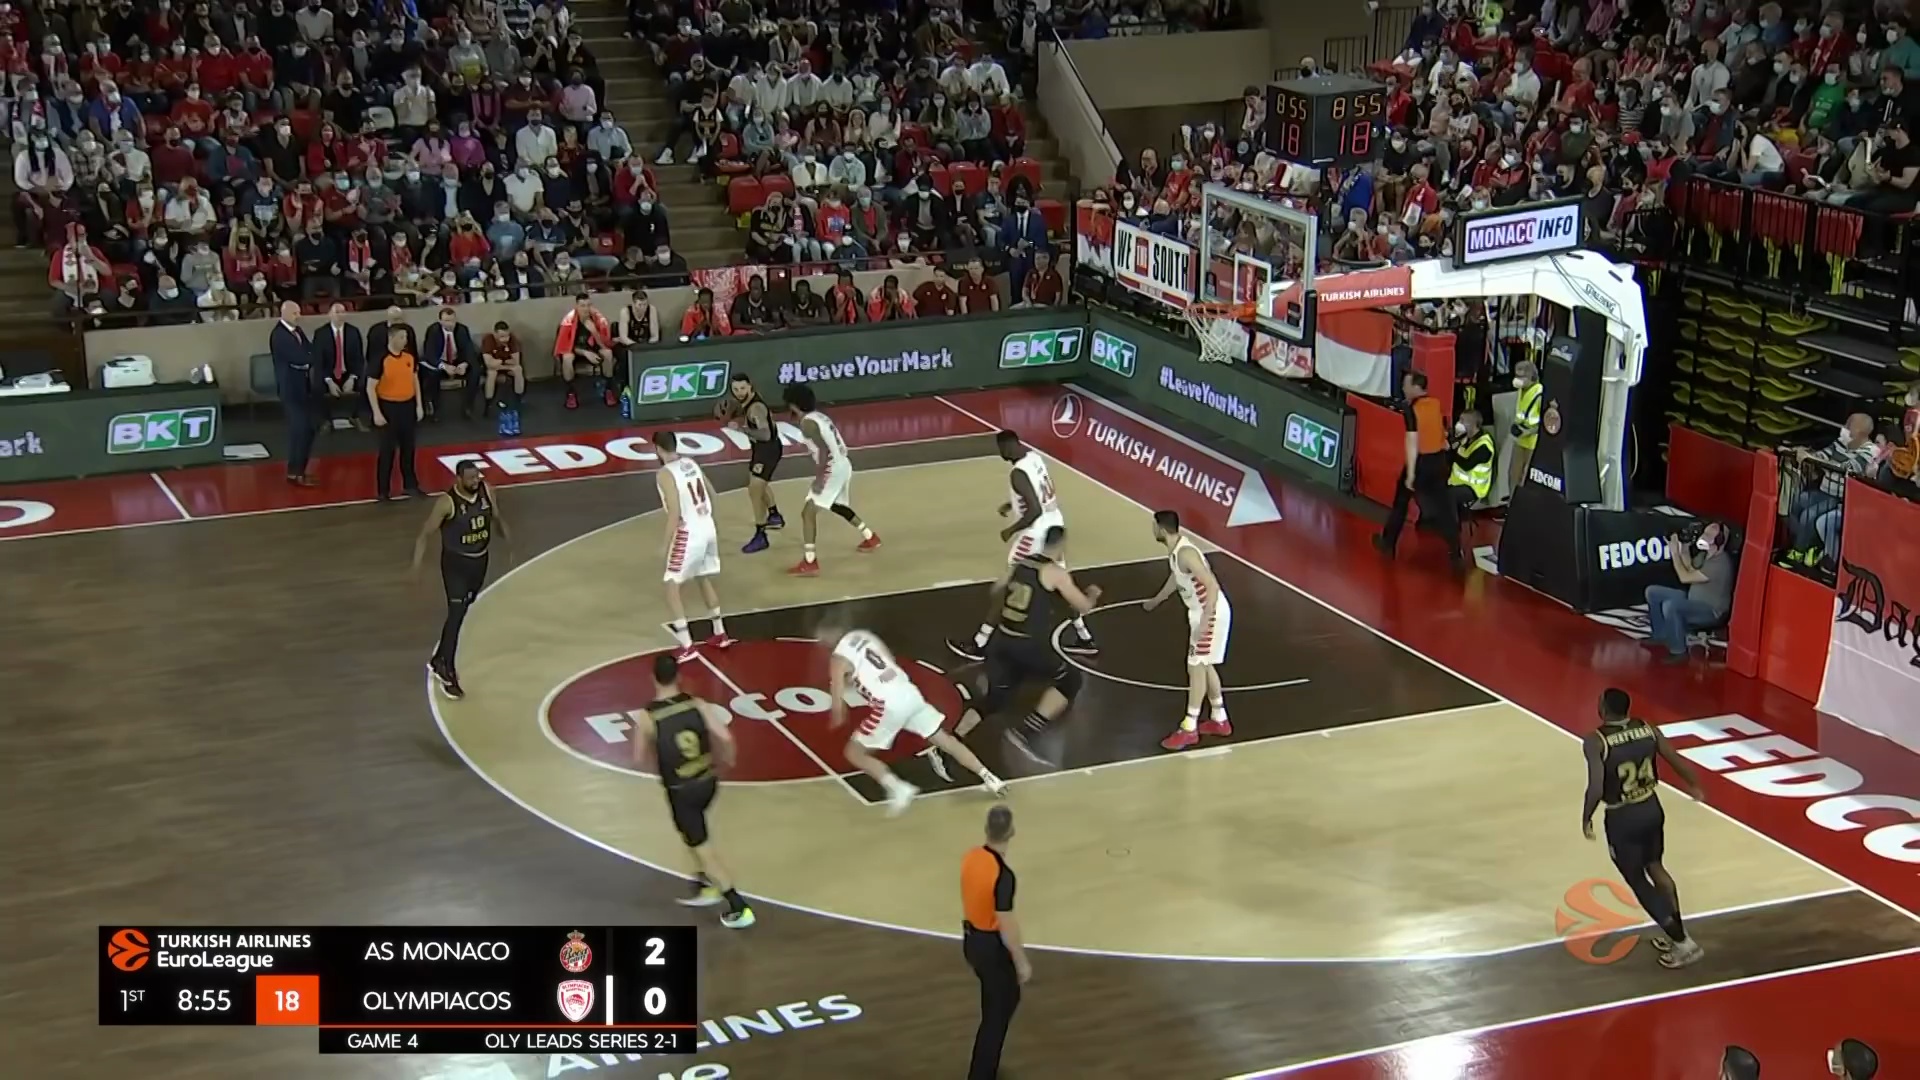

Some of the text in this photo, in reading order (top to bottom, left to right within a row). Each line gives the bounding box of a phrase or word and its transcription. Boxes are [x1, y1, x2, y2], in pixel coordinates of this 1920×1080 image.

[1280, 121, 1300, 156] 18
[1339, 121, 1371, 155] 18
[1470, 215, 1573, 251] MONACO INFO
[1117, 229, 1132, 270] WE
[1153, 243, 1188, 292] SOUTH
[1320, 287, 1405, 302] TURKISH AIRLINES
[1004, 335, 1078, 360] BKT
[1093, 339, 1133, 368] BKT
[643, 369, 724, 396] BKT
[778, 348, 954, 384] #LeaveYourMark
[1160, 365, 1259, 427] #LeaveYourMark
[113, 416, 209, 445] BKT
[1288, 421, 1336, 458] BKT
[1086, 417, 1237, 507] TURKISH AIRLINES
[1530, 467, 1562, 491] FEDCOM
[471, 515, 485, 530] 10
[675, 730, 701, 759] 9
[1617, 757, 1656, 792] 24
